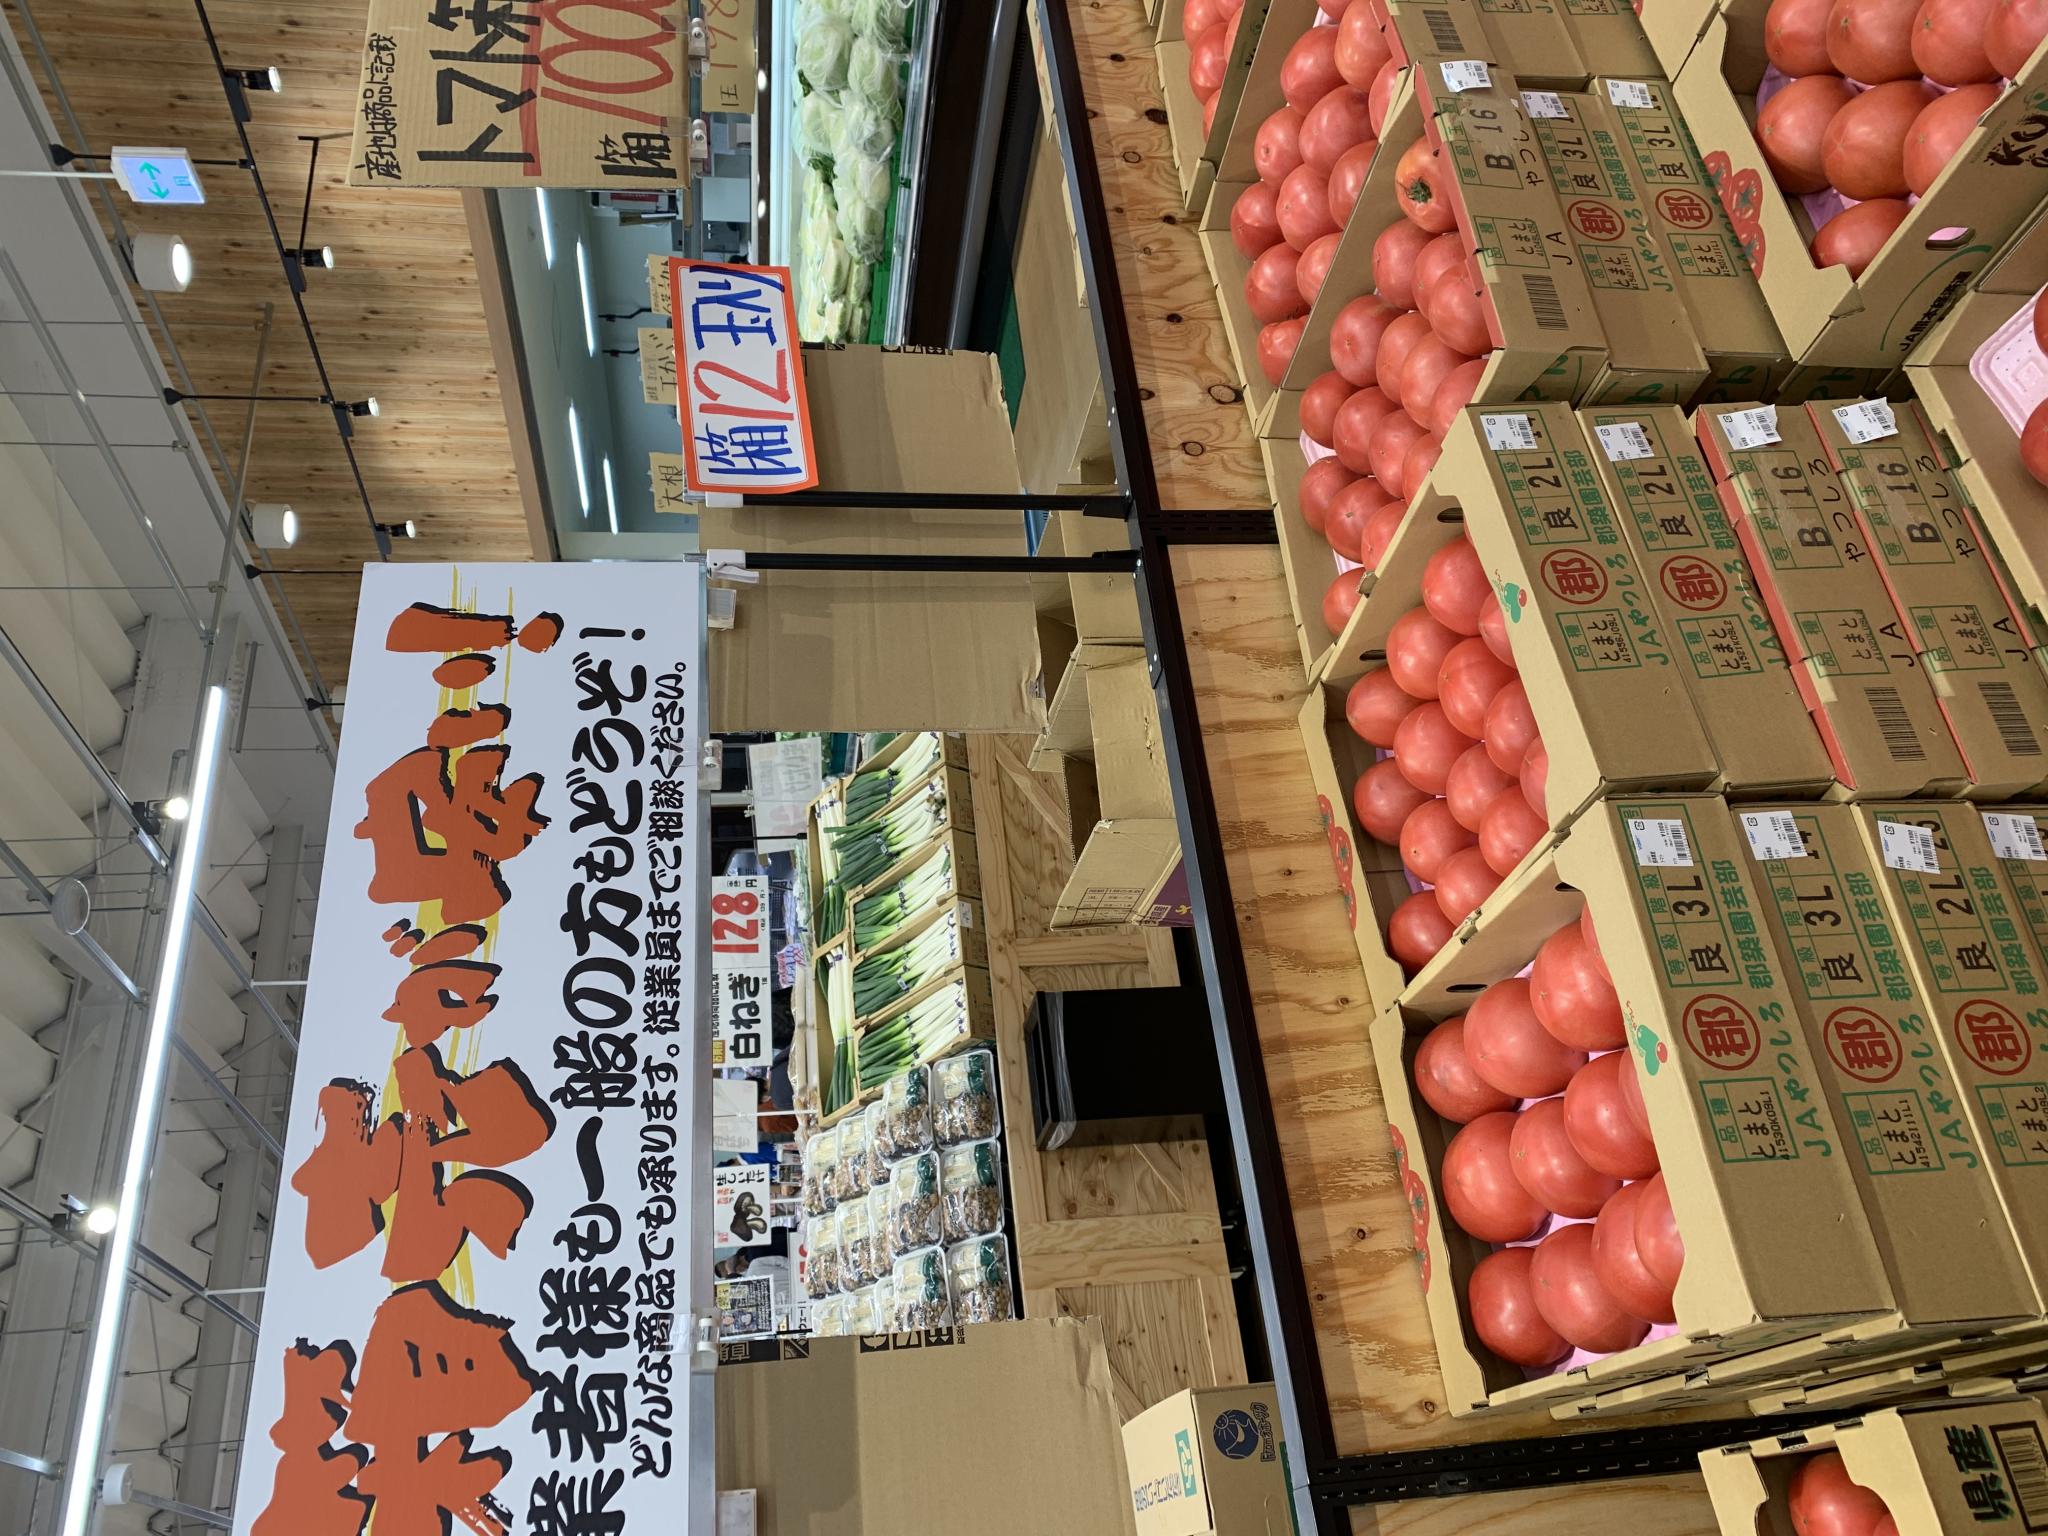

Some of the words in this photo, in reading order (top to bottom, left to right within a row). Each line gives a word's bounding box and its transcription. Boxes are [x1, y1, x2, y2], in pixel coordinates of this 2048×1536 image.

[355, 33, 401, 179] 産地は商品に記載
[1469, 109, 1503, 134] 16
[1560, 136, 1588, 160] 3L
[1643, 125, 1677, 148] 3L
[1484, 153, 1515, 171] B
[1572, 173, 1601, 190] 良
[1659, 161, 1690, 179] 良
[1508, 221, 1534, 255] とまと
[1546, 231, 1574, 266] JA
[1603, 256, 1631, 288] とまと
[1692, 244, 1721, 275] とまと
[656, 464, 684, 506] 大根
[1503, 461, 1525, 492] 階級
[1522, 456, 1563, 488] 2L
[1620, 466, 1642, 497] 階級
[1638, 464, 1675, 495] 2L
[1771, 465, 1813, 497] 16
[1875, 462, 1919, 493] 16
[1563, 449, 1618, 545] 郡築園芸部
[1805, 457, 1867, 563] やつしろ
[1915, 455, 1977, 558] やつしろ
[1520, 505, 1543, 536] 等級
[1542, 506, 1579, 530] 良
[1637, 511, 1659, 543] 等級
[1660, 514, 1693, 536] 良
[1796, 526, 1833, 548] B
[1904, 522, 1942, 544] B
[1564, 624, 1590, 658] 品種
[1587, 619, 1621, 662] とまと
[1685, 631, 1710, 665] 品種
[1707, 627, 1742, 670] とまと
[1837, 617, 1873, 660] とまと
[1879, 621, 1916, 668] JA
[1917, 614, 1951, 662] 品種
[1949, 613, 1986, 655] とまと
[1993, 616, 2030, 663] JA
[1642, 872, 1666, 914] 階級
[1666, 874, 1711, 917] 3L
[1778, 886, 1802, 927] 階級
[1798, 885, 1842, 928] 3L
[1899, 878, 1928, 920] 階級
[1929, 874, 1975, 915] 2L
[711, 892, 759, 954] 128
[1711, 858, 1775, 989] 郡築園芸部
[1844, 871, 1914, 1001] 郡築園芸部
[1969, 866, 2039, 995] 郡築園芸部
[1661, 933, 1686, 976] 等級
[1689, 942, 1730, 974] 良
[1797, 945, 1823, 988] 等級
[1821, 952, 1864, 984] 良
[1925, 939, 1953, 980] 等級
[1955, 941, 1997, 972] 良
[728, 972, 761, 1059] 白ねぎ
[1708, 1097, 1739, 1145] 品種
[1738, 1099, 1778, 1160] とまと
[1853, 1109, 1884, 1156] 品種
[1876, 1107, 1918, 1166] とまと
[1986, 1102, 2018, 1148] 品種
[715, 1168, 765, 1186] 生しいたけ
[1943, 1423, 2016, 1523] 県産
